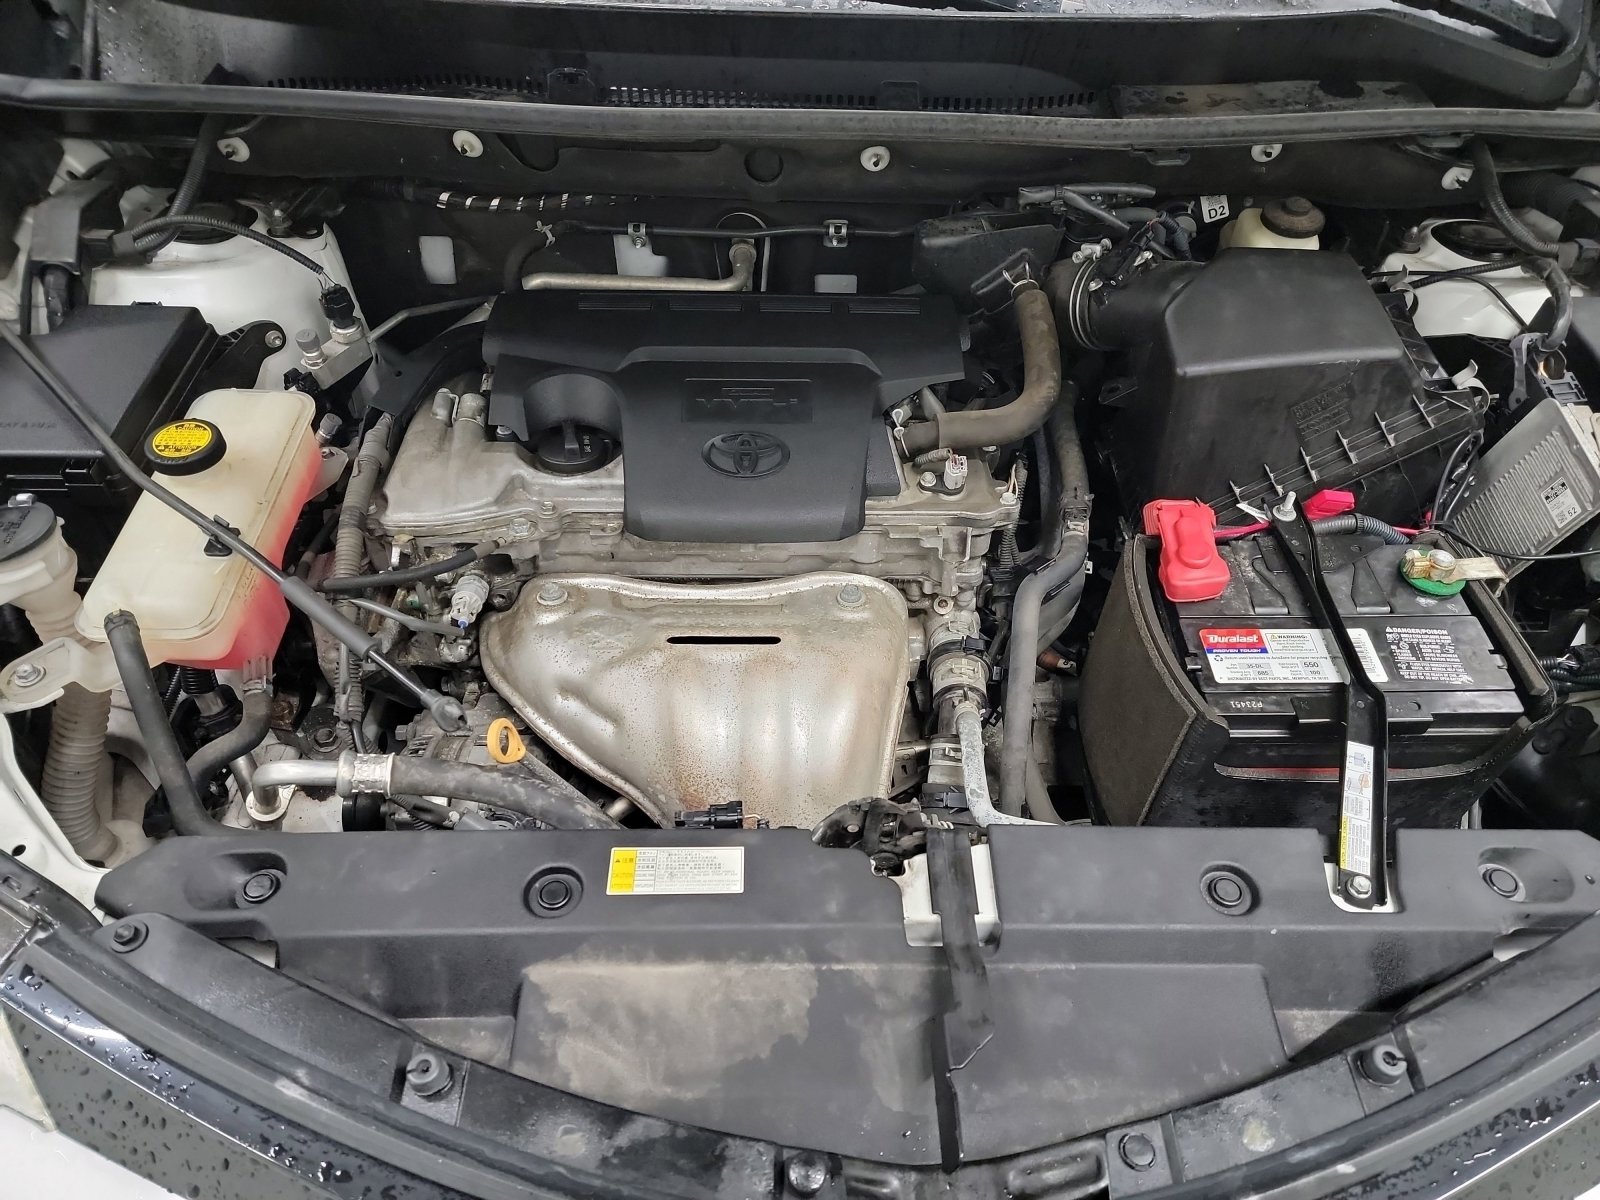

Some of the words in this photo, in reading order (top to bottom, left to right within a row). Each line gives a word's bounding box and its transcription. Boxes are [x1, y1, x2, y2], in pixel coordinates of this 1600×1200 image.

[1208, 205, 1226, 219] D2
[1567, 506, 1578, 517] 52
[1205, 634, 1259, 644] Duralast
[1230, 700, 1263, 709] P23451
